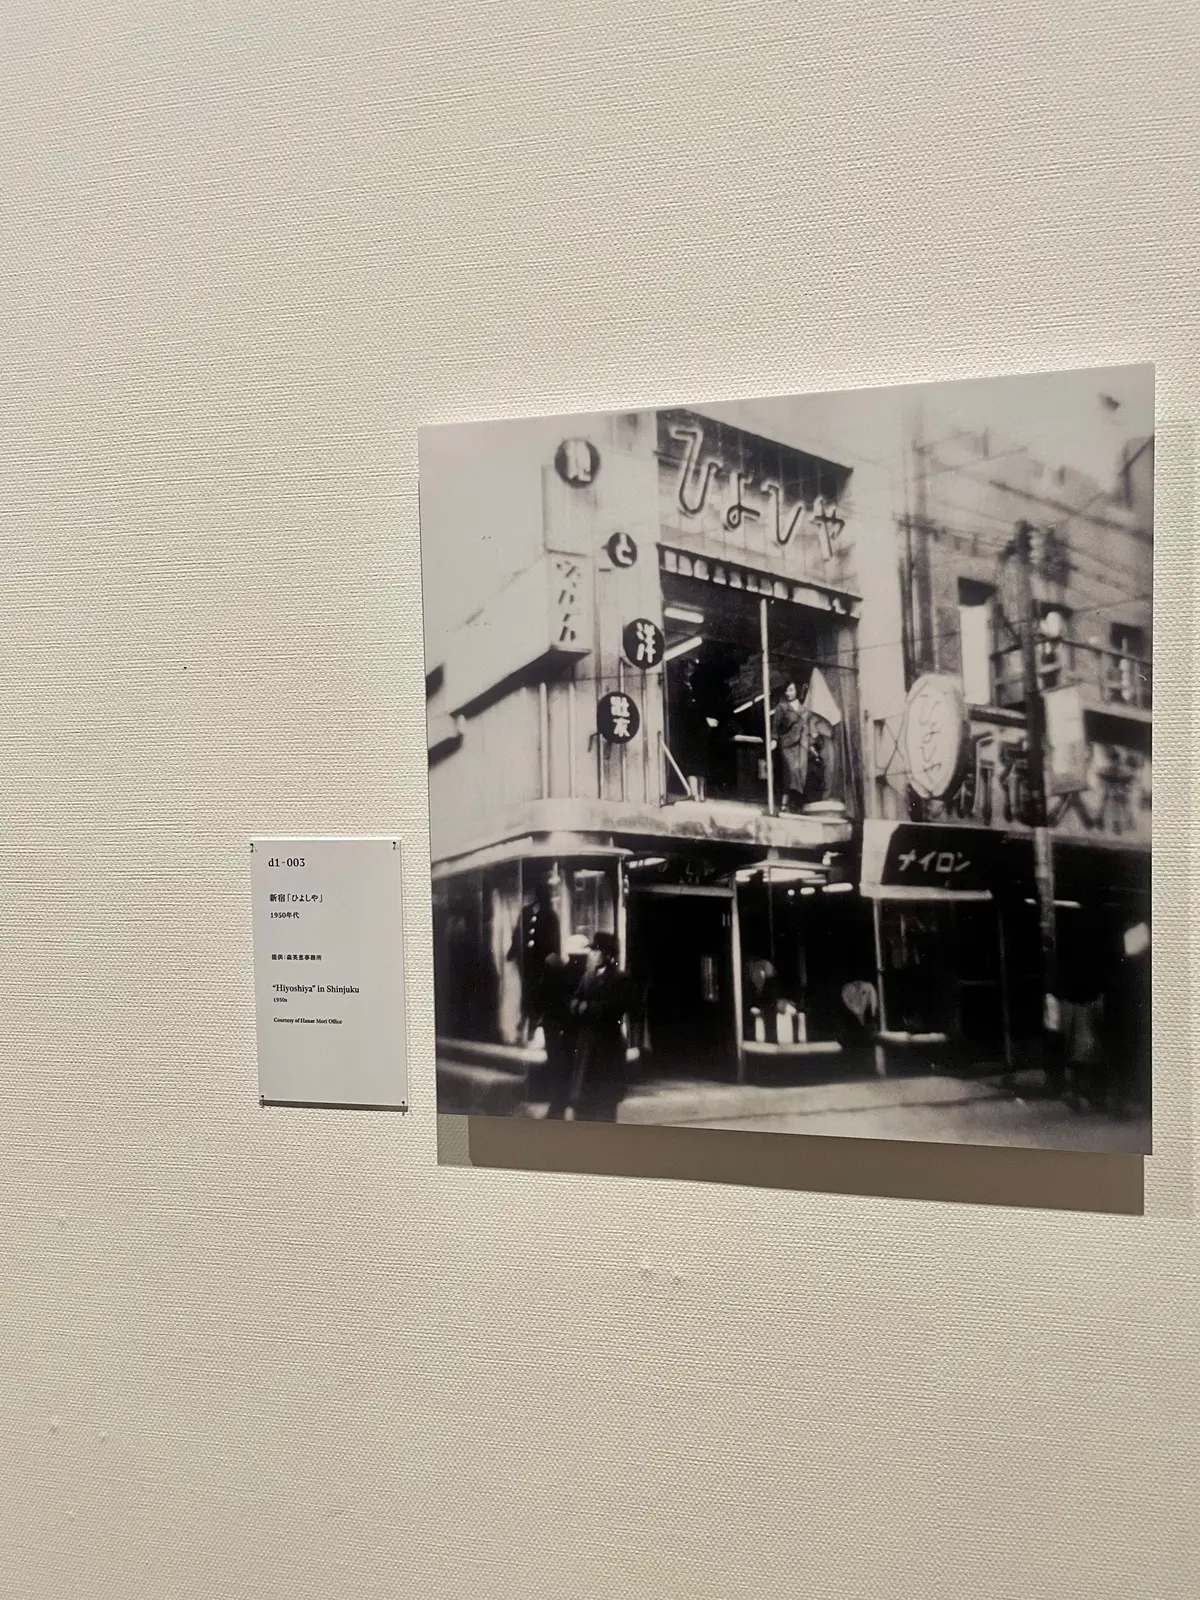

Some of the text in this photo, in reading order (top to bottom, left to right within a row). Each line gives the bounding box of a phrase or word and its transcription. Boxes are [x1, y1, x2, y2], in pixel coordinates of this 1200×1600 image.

[669, 424, 846, 561] ひよしや
[268, 857, 306, 867] d1-003
[898, 849, 971, 873] ナイロン
[269, 893, 324, 903] 新宿「ひよしや」
[270, 911, 300, 919] 1950年代
[317, 985, 325, 993] in
[326, 985, 360, 995] Shinjuku
